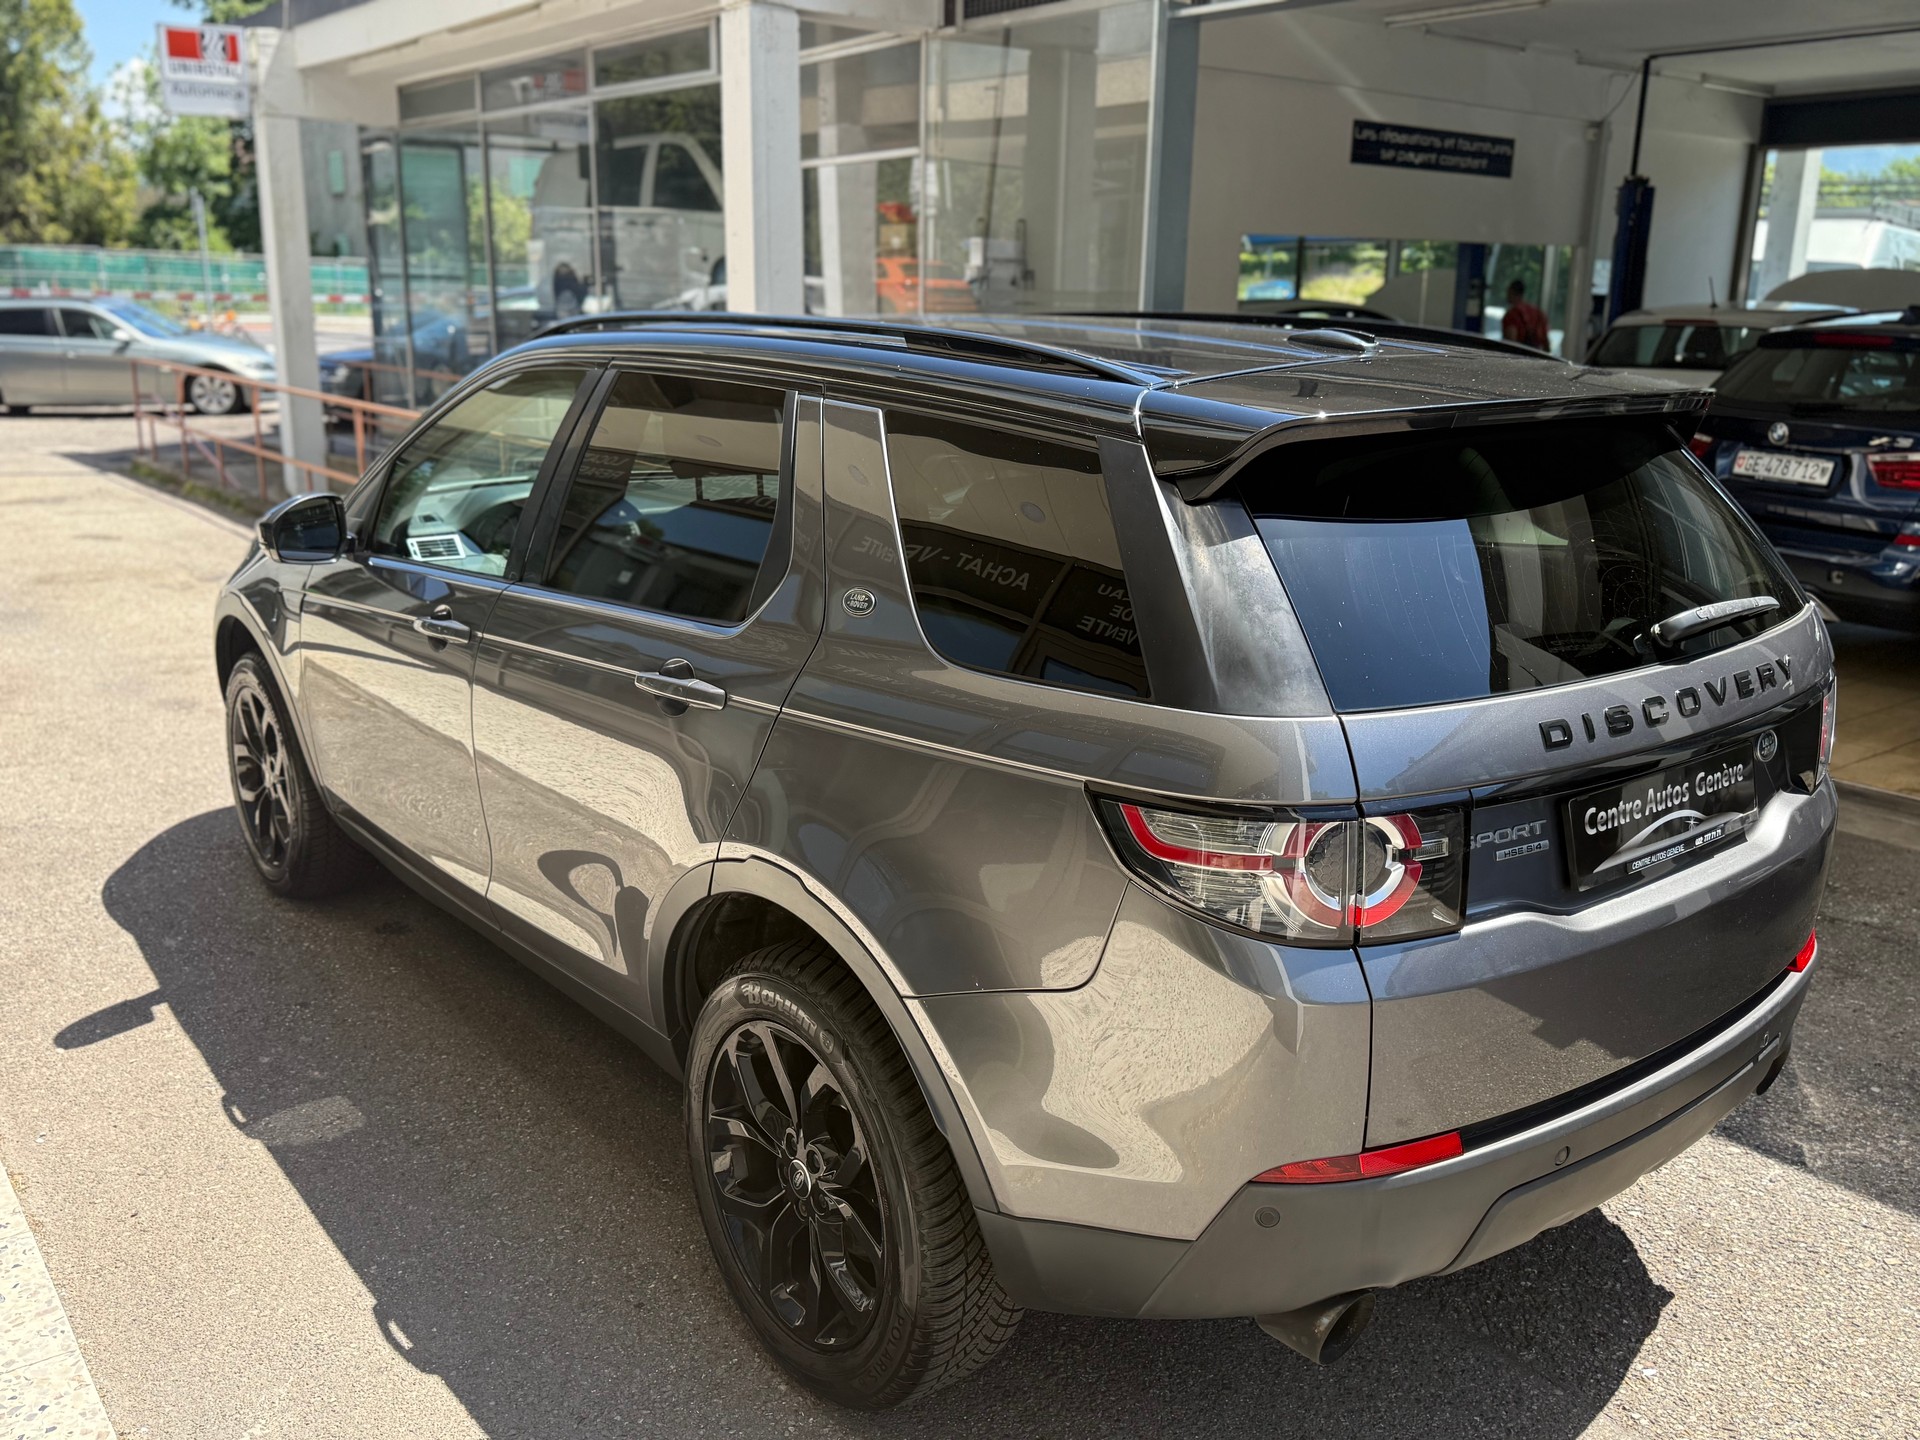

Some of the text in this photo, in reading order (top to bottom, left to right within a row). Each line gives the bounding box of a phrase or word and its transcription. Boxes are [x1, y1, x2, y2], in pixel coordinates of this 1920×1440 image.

[1538, 653, 1794, 752] DISCOVERY
[1584, 763, 1744, 836] Centre Autos Genève
[1504, 847, 1524, 858] HSE
[1631, 856, 1651, 870] CENTRE
[1651, 850, 1667, 863] AUTOS
[741, 981, 817, 1038] Barum
